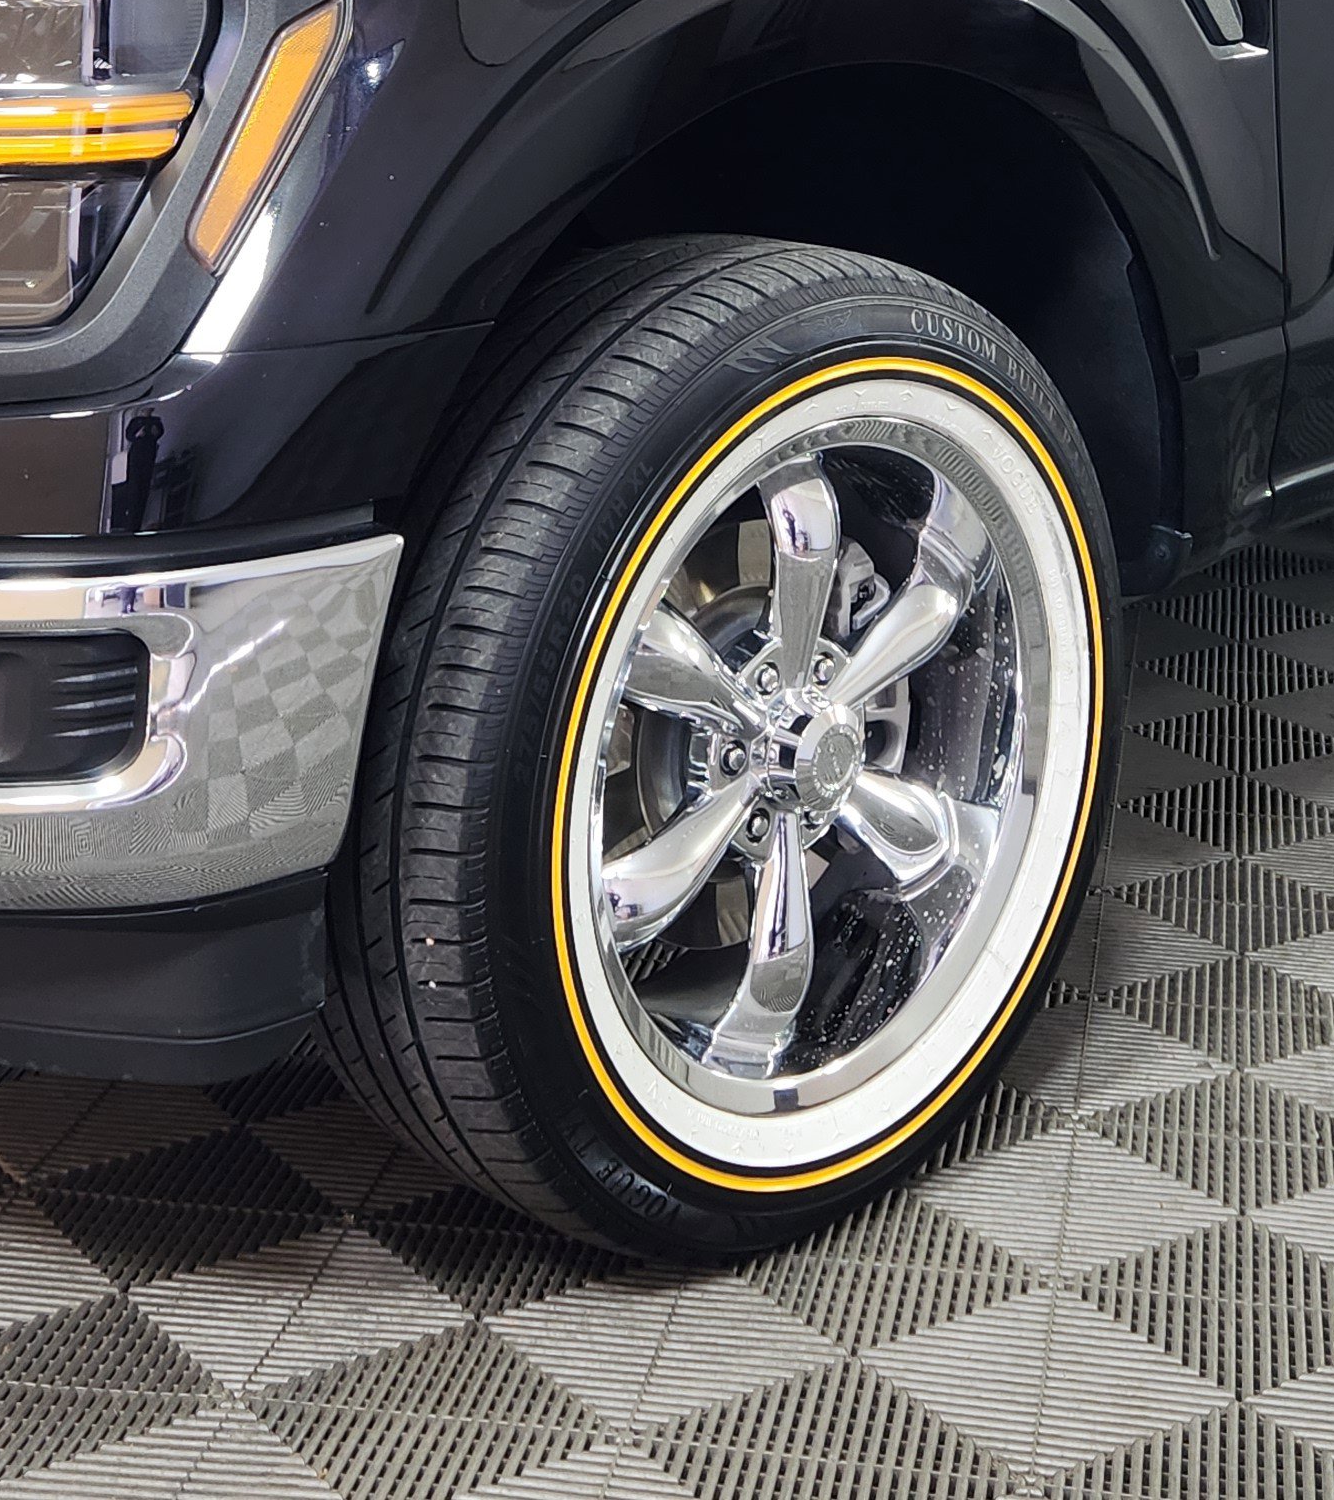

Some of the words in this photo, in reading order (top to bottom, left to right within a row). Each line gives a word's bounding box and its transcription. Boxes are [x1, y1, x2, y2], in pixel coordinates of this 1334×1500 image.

[910, 309, 998, 365] CUSTOM
[1005, 355, 1056, 422] BUILT
[625, 455, 654, 496] XL
[991, 444, 1040, 515] VOGUE
[594, 1150, 681, 1229] VOGUE
